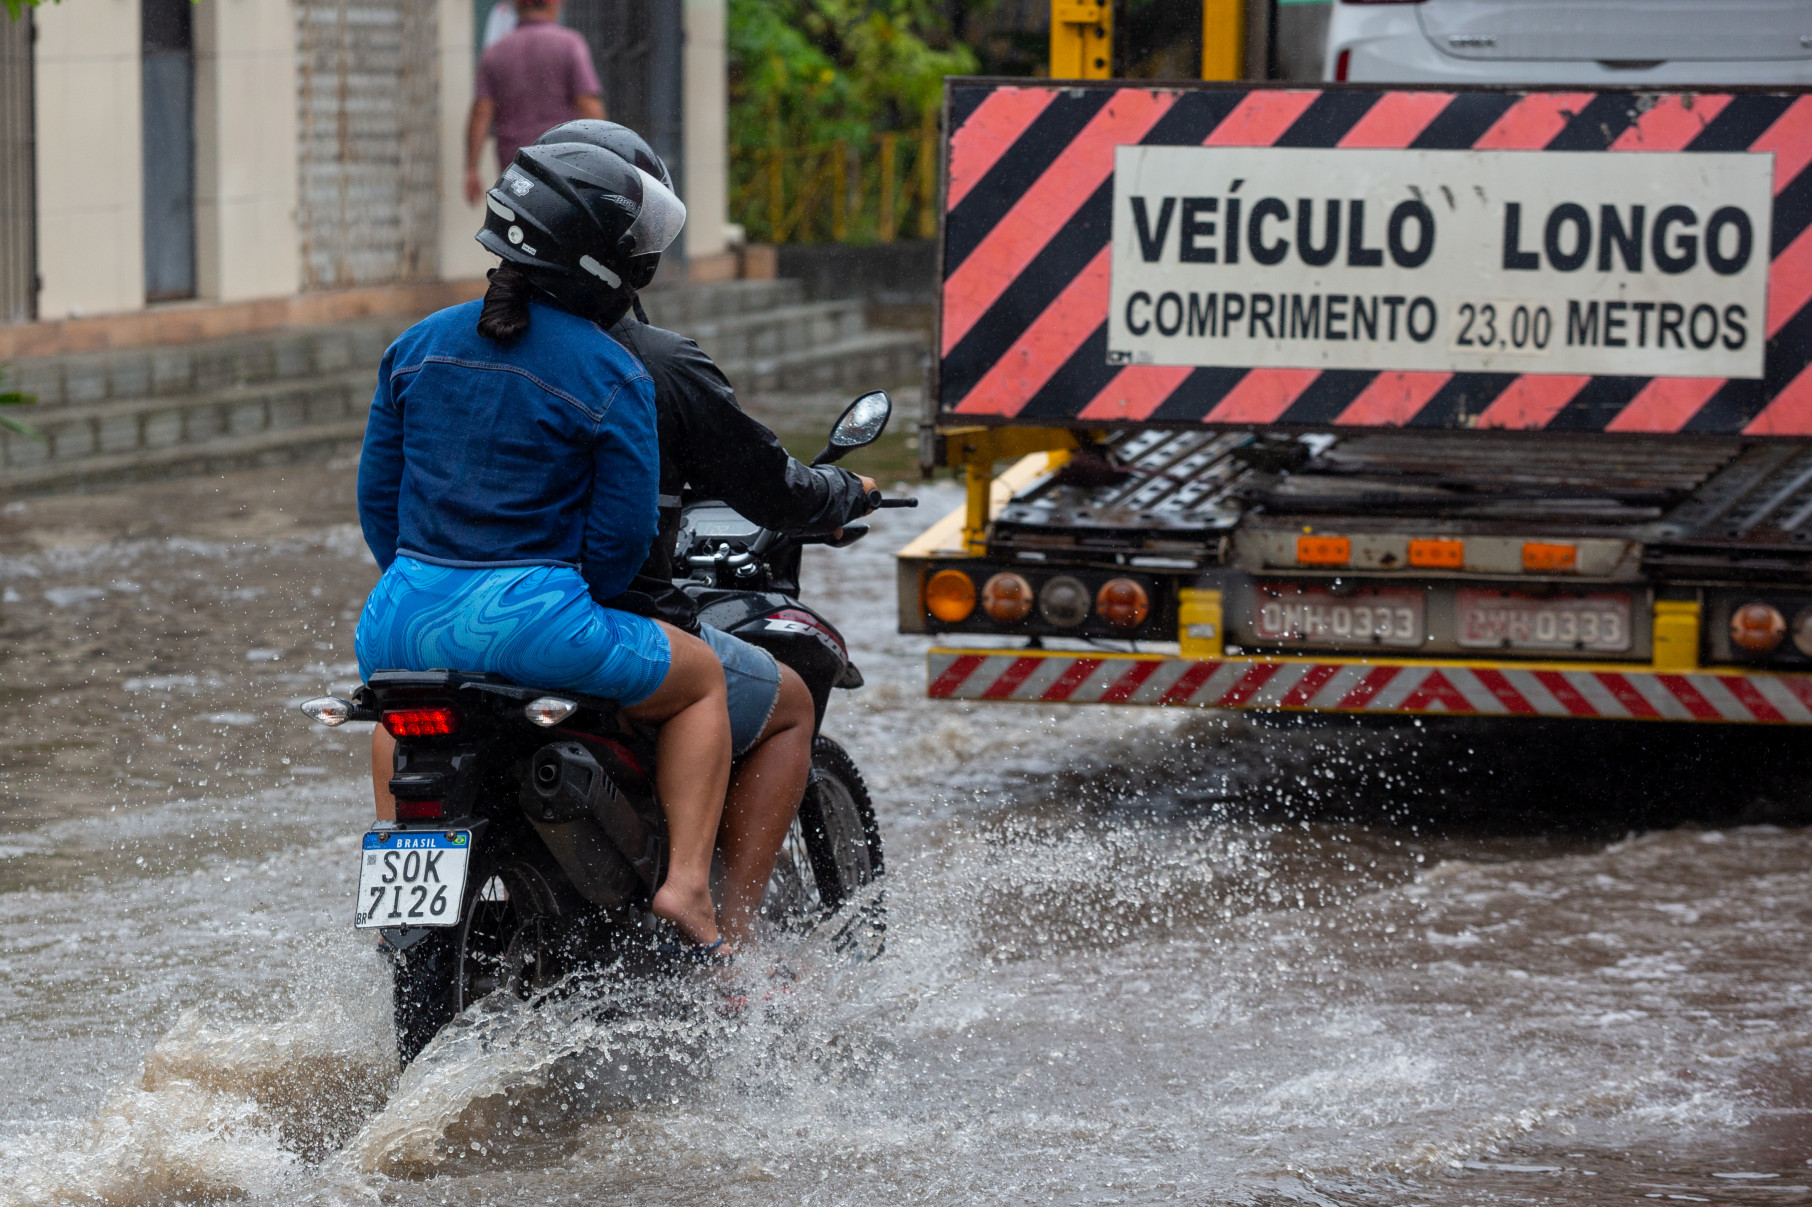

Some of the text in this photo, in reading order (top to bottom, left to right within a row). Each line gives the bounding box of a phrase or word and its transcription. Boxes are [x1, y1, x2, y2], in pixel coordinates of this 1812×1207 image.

[1129, 179, 1754, 276] VEÍCULO LONGO
[1125, 291, 1437, 342] COMPRIMENTO
[1566, 300, 1748, 351] METROS
[396, 838, 437, 848] BRASIL
[381, 850, 444, 883] SOK
[356, 912, 367, 924] BR
